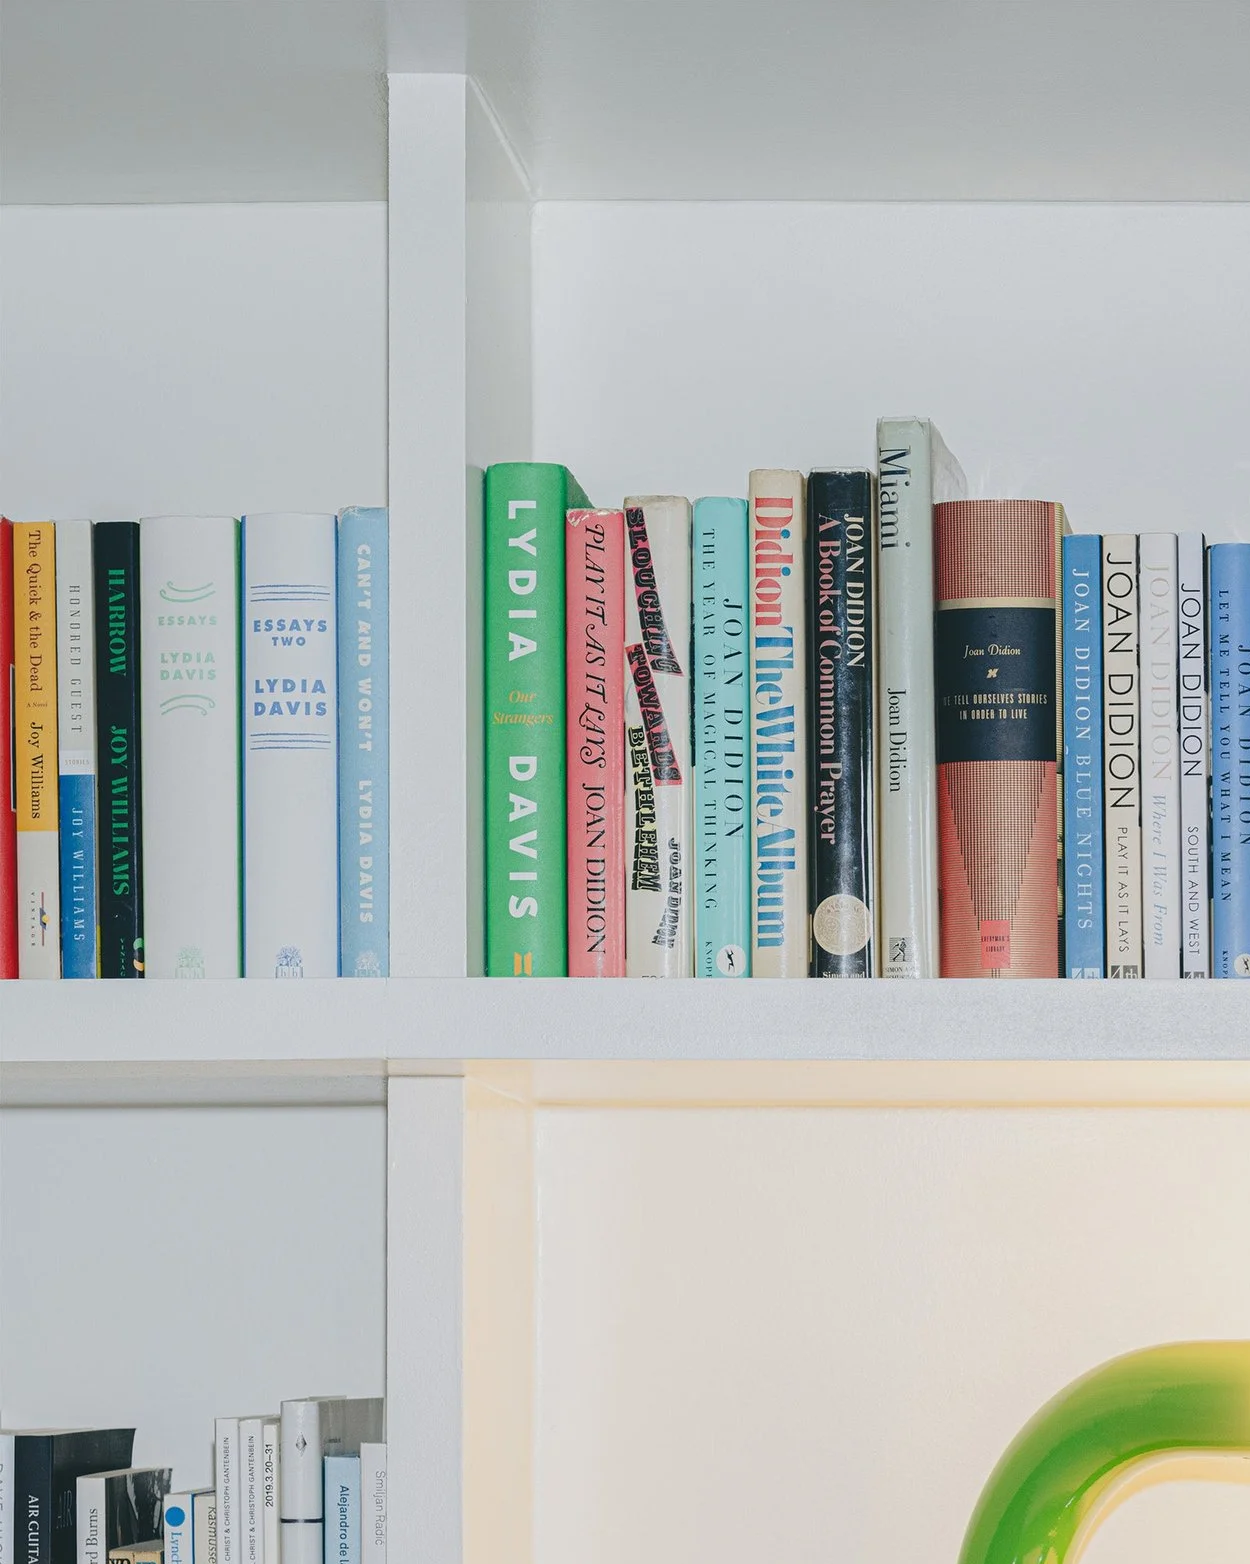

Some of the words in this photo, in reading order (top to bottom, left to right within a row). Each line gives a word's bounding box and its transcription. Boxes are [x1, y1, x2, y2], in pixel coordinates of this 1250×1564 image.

[819, 514, 834, 532] A
[879, 448, 909, 551] Miami
[29, 530, 40, 557] The
[703, 528, 714, 569] THE
[844, 514, 864, 573] JOAN
[26, 563, 41, 605] Quick
[509, 501, 537, 661] LYDIA
[820, 540, 841, 604] Book
[29, 611, 41, 621] &
[109, 570, 126, 675] HARROW
[703, 583, 715, 641] YEAR
[820, 610, 840, 637] of
[1073, 569, 1089, 632] JOAN
[1219, 591, 1229, 621] LET
[30, 626, 42, 648] the
[254, 619, 327, 632] ESSAYS
[272, 637, 305, 646] TWO
[357, 621, 371, 666] AND
[845, 582, 864, 667] DIDION
[1220, 635, 1229, 657] ME
[30, 655, 42, 691] Dead
[255, 679, 325, 693] LYDIA
[704, 655, 715, 680] OF
[1220, 669, 1229, 713] TELL
[254, 702, 326, 716] DAVIS
[819, 640, 842, 754] Common
[1075, 647, 1090, 740] DIDION
[704, 693, 716, 790] MAGICAL
[1220, 726, 1230, 760] YOU
[814, 762, 841, 844] Prayer
[1077, 755, 1091, 818] BLUE
[1221, 772, 1230, 820] WHAT
[358, 781, 372, 845] LYDIA
[509, 756, 537, 917] DAVIS
[705, 800, 716, 908] THINKING
[1221, 853, 1231, 900] MEAN
[359, 857, 373, 922] DAVIS
[1077, 833, 1092, 928] NIGHTS
[29, 1495, 39, 1517] AIR
[337, 1485, 349, 1539] Alejandro
[340, 1543, 349, 1556] de
